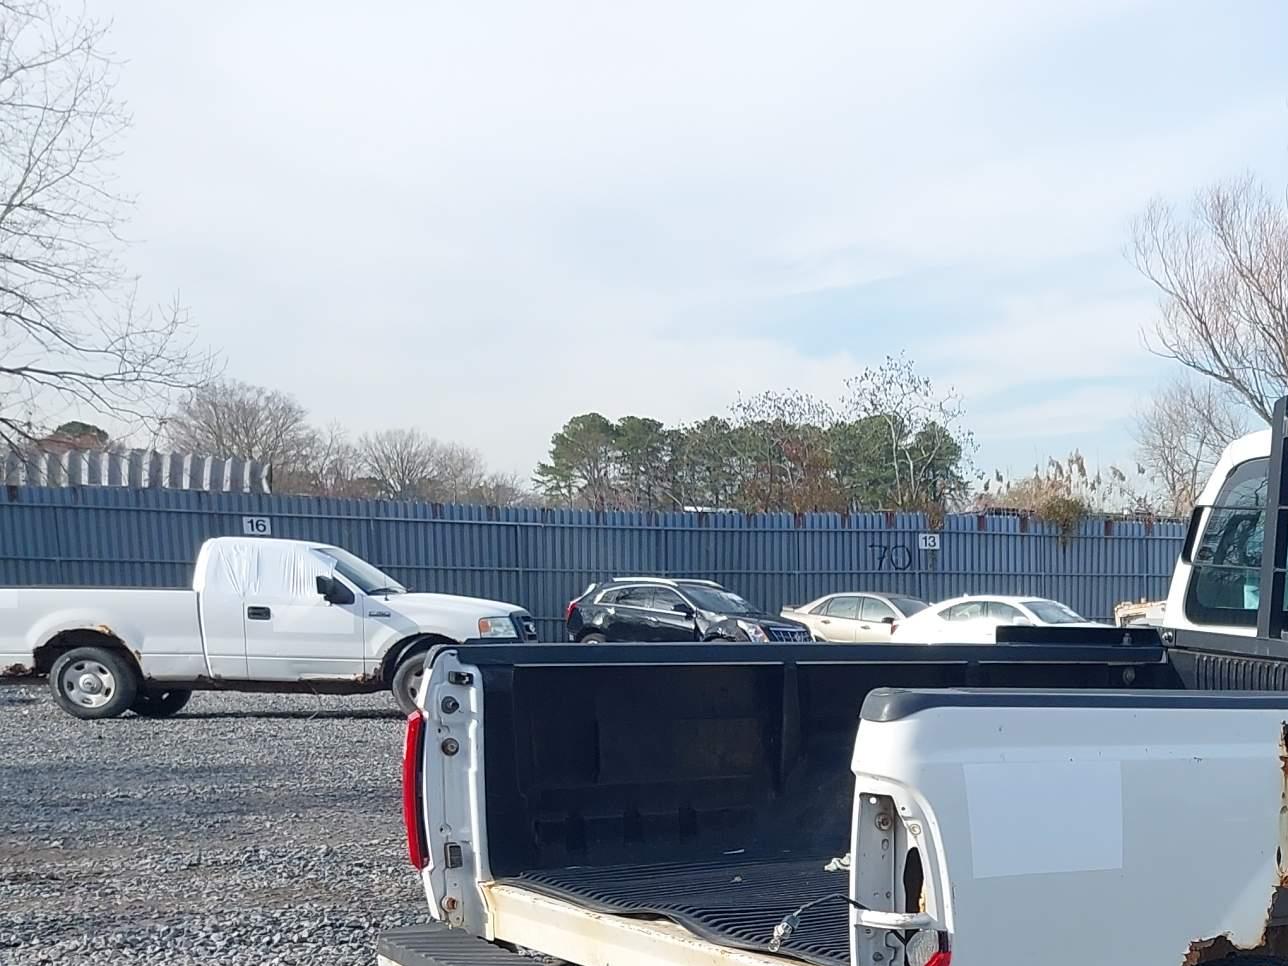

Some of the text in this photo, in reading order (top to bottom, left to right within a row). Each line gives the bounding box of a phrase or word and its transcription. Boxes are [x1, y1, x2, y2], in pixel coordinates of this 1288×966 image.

[247, 518, 267, 533] 16
[921, 535, 937, 548] 13
[868, 544, 912, 571] 70
